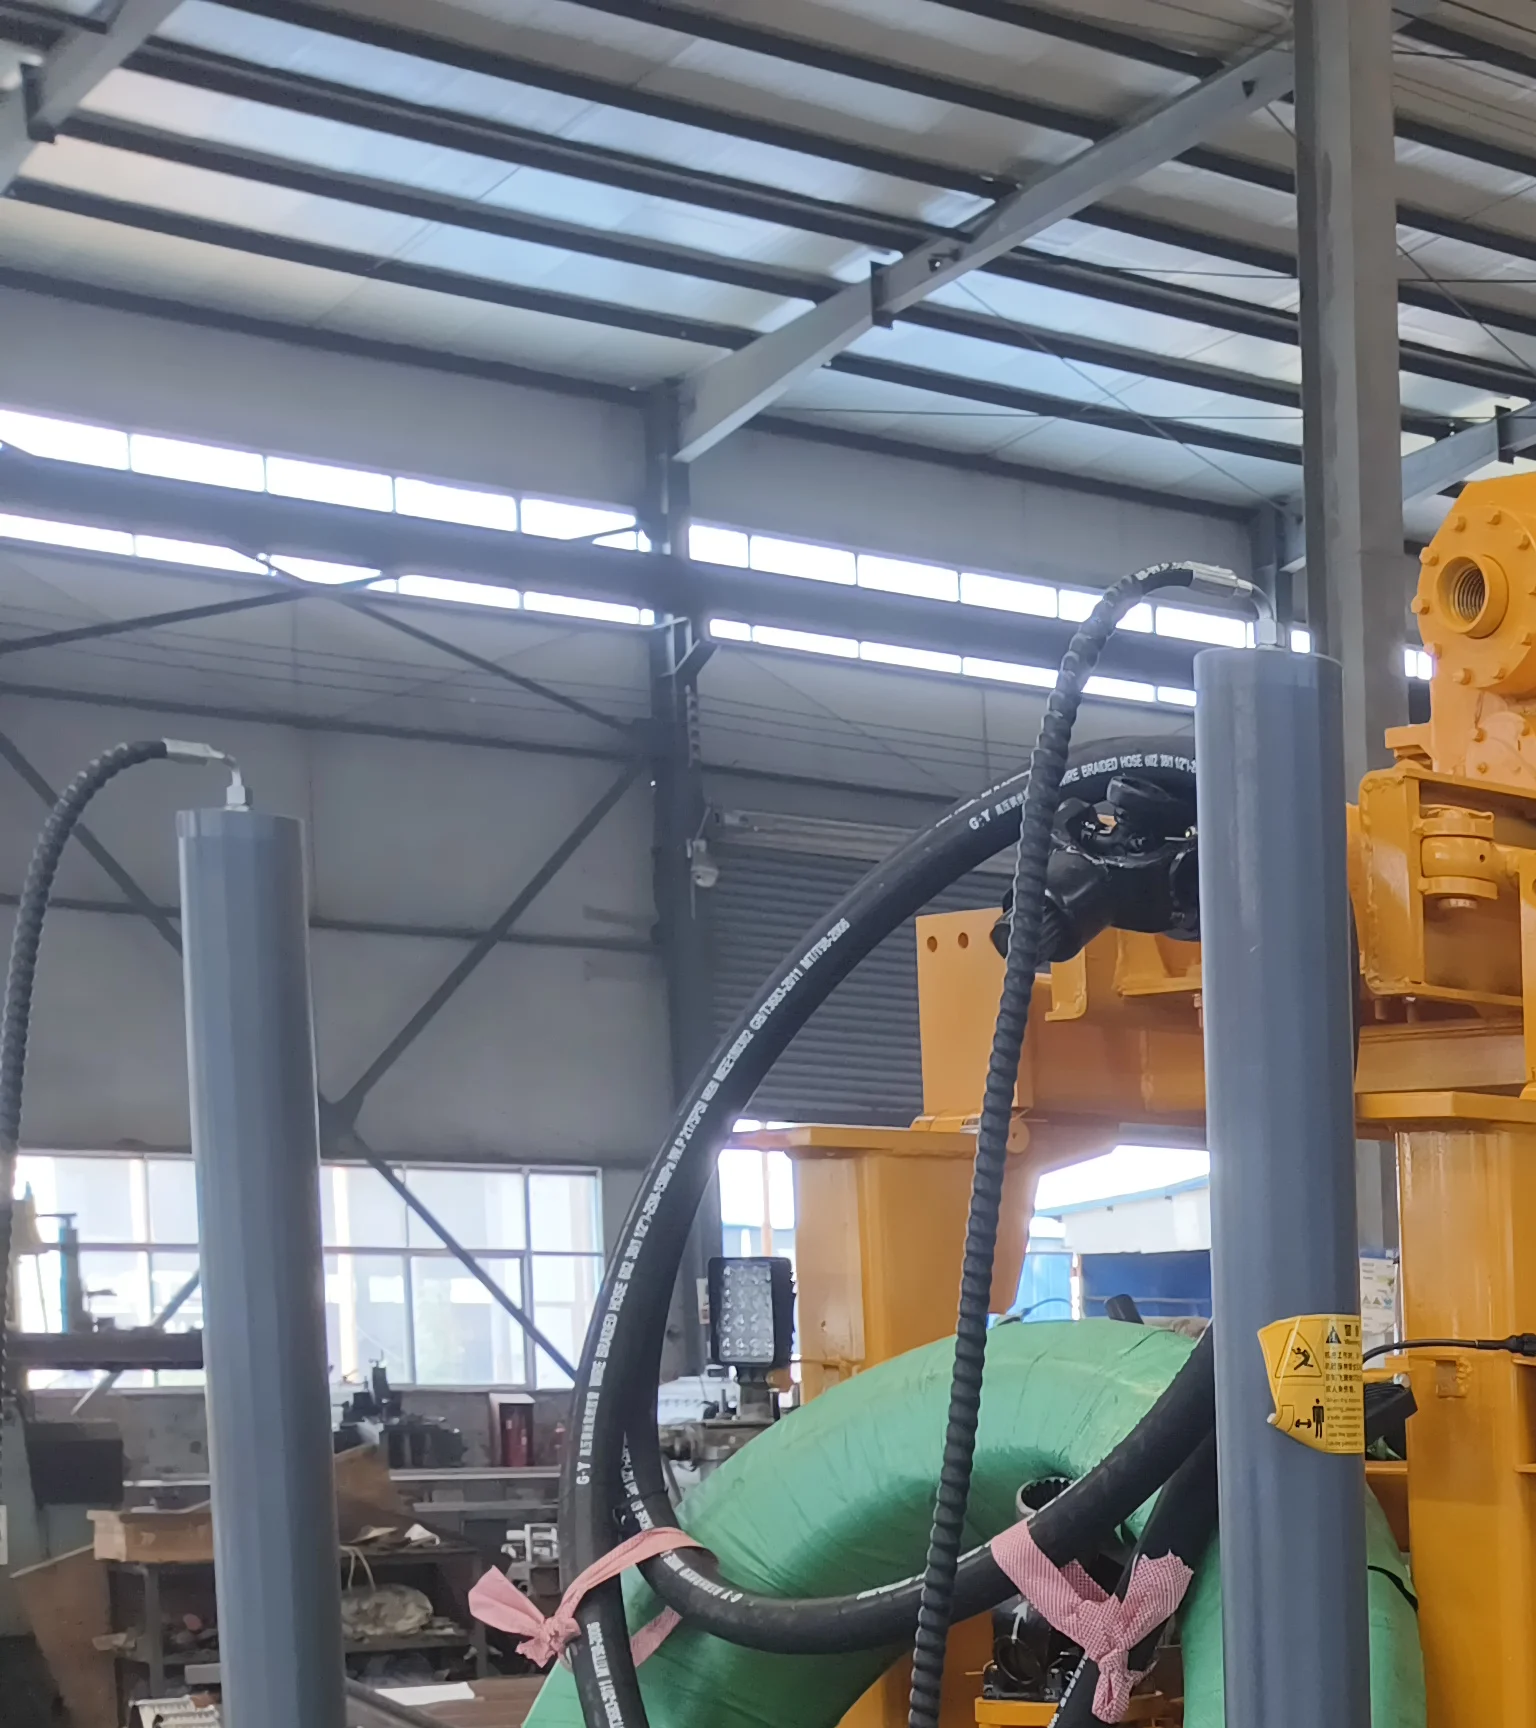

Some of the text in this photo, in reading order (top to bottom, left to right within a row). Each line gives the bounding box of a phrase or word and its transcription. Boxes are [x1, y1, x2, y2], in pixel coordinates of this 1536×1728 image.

[1081, 756, 1118, 778] BRAIDED
[1120, 754, 1142, 768] HOSE
[595, 1313, 618, 1358] BRAIDED
[608, 1281, 628, 1311] HOSE
